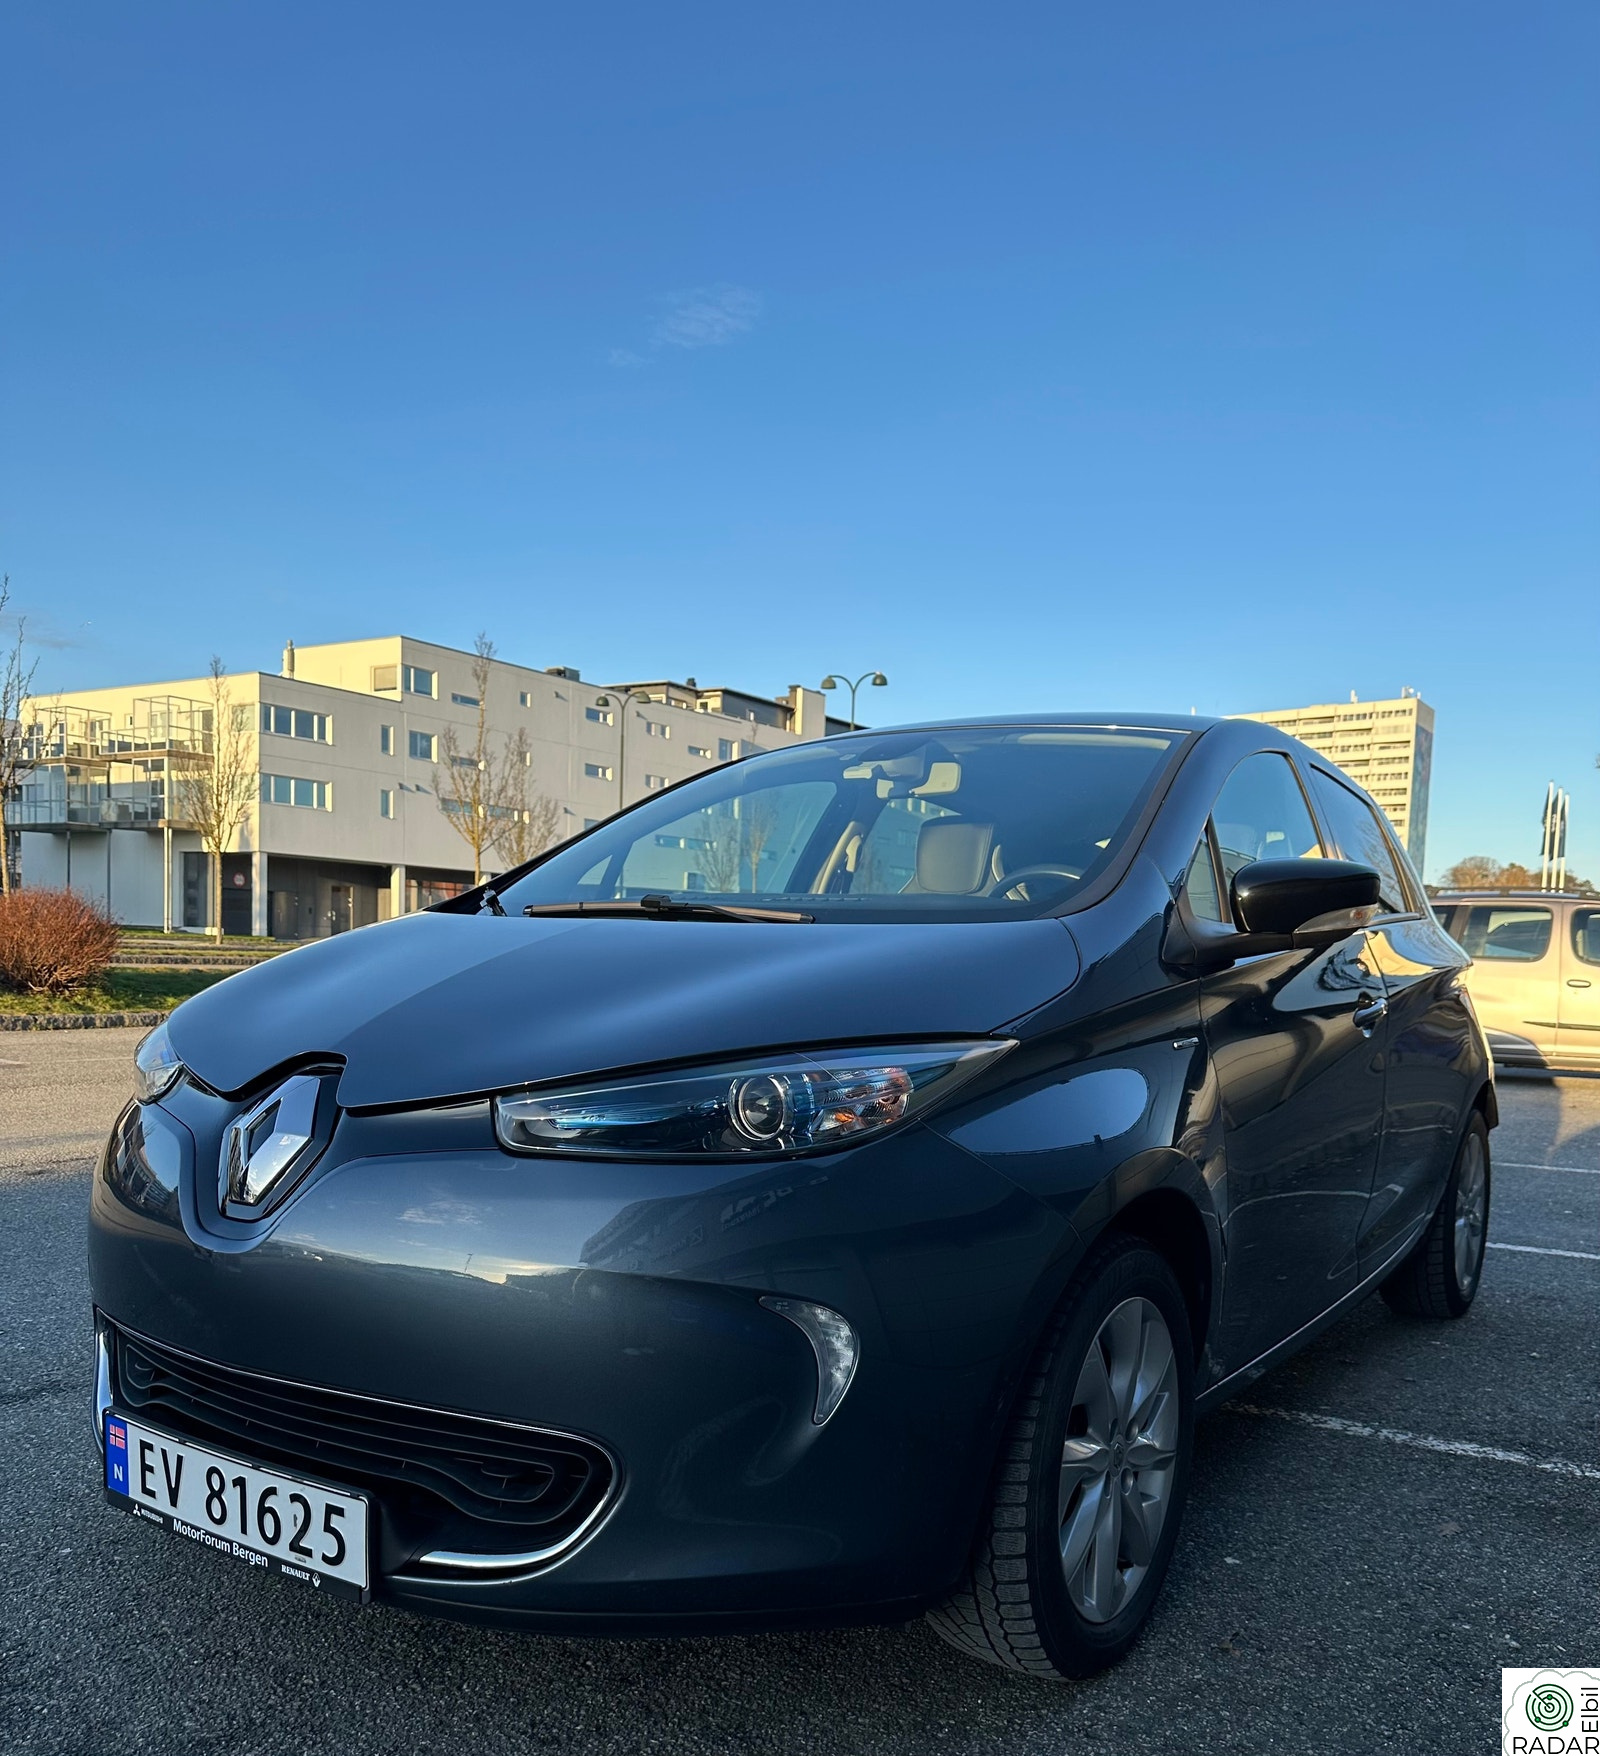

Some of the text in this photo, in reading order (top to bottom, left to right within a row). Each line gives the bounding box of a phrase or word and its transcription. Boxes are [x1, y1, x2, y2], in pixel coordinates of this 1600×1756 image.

[113, 1463, 124, 1482] N
[139, 1438, 347, 1567] EV 81625
[173, 1518, 269, 1568] MotorForum Bergen
[281, 1564, 311, 1581] RENAULT
